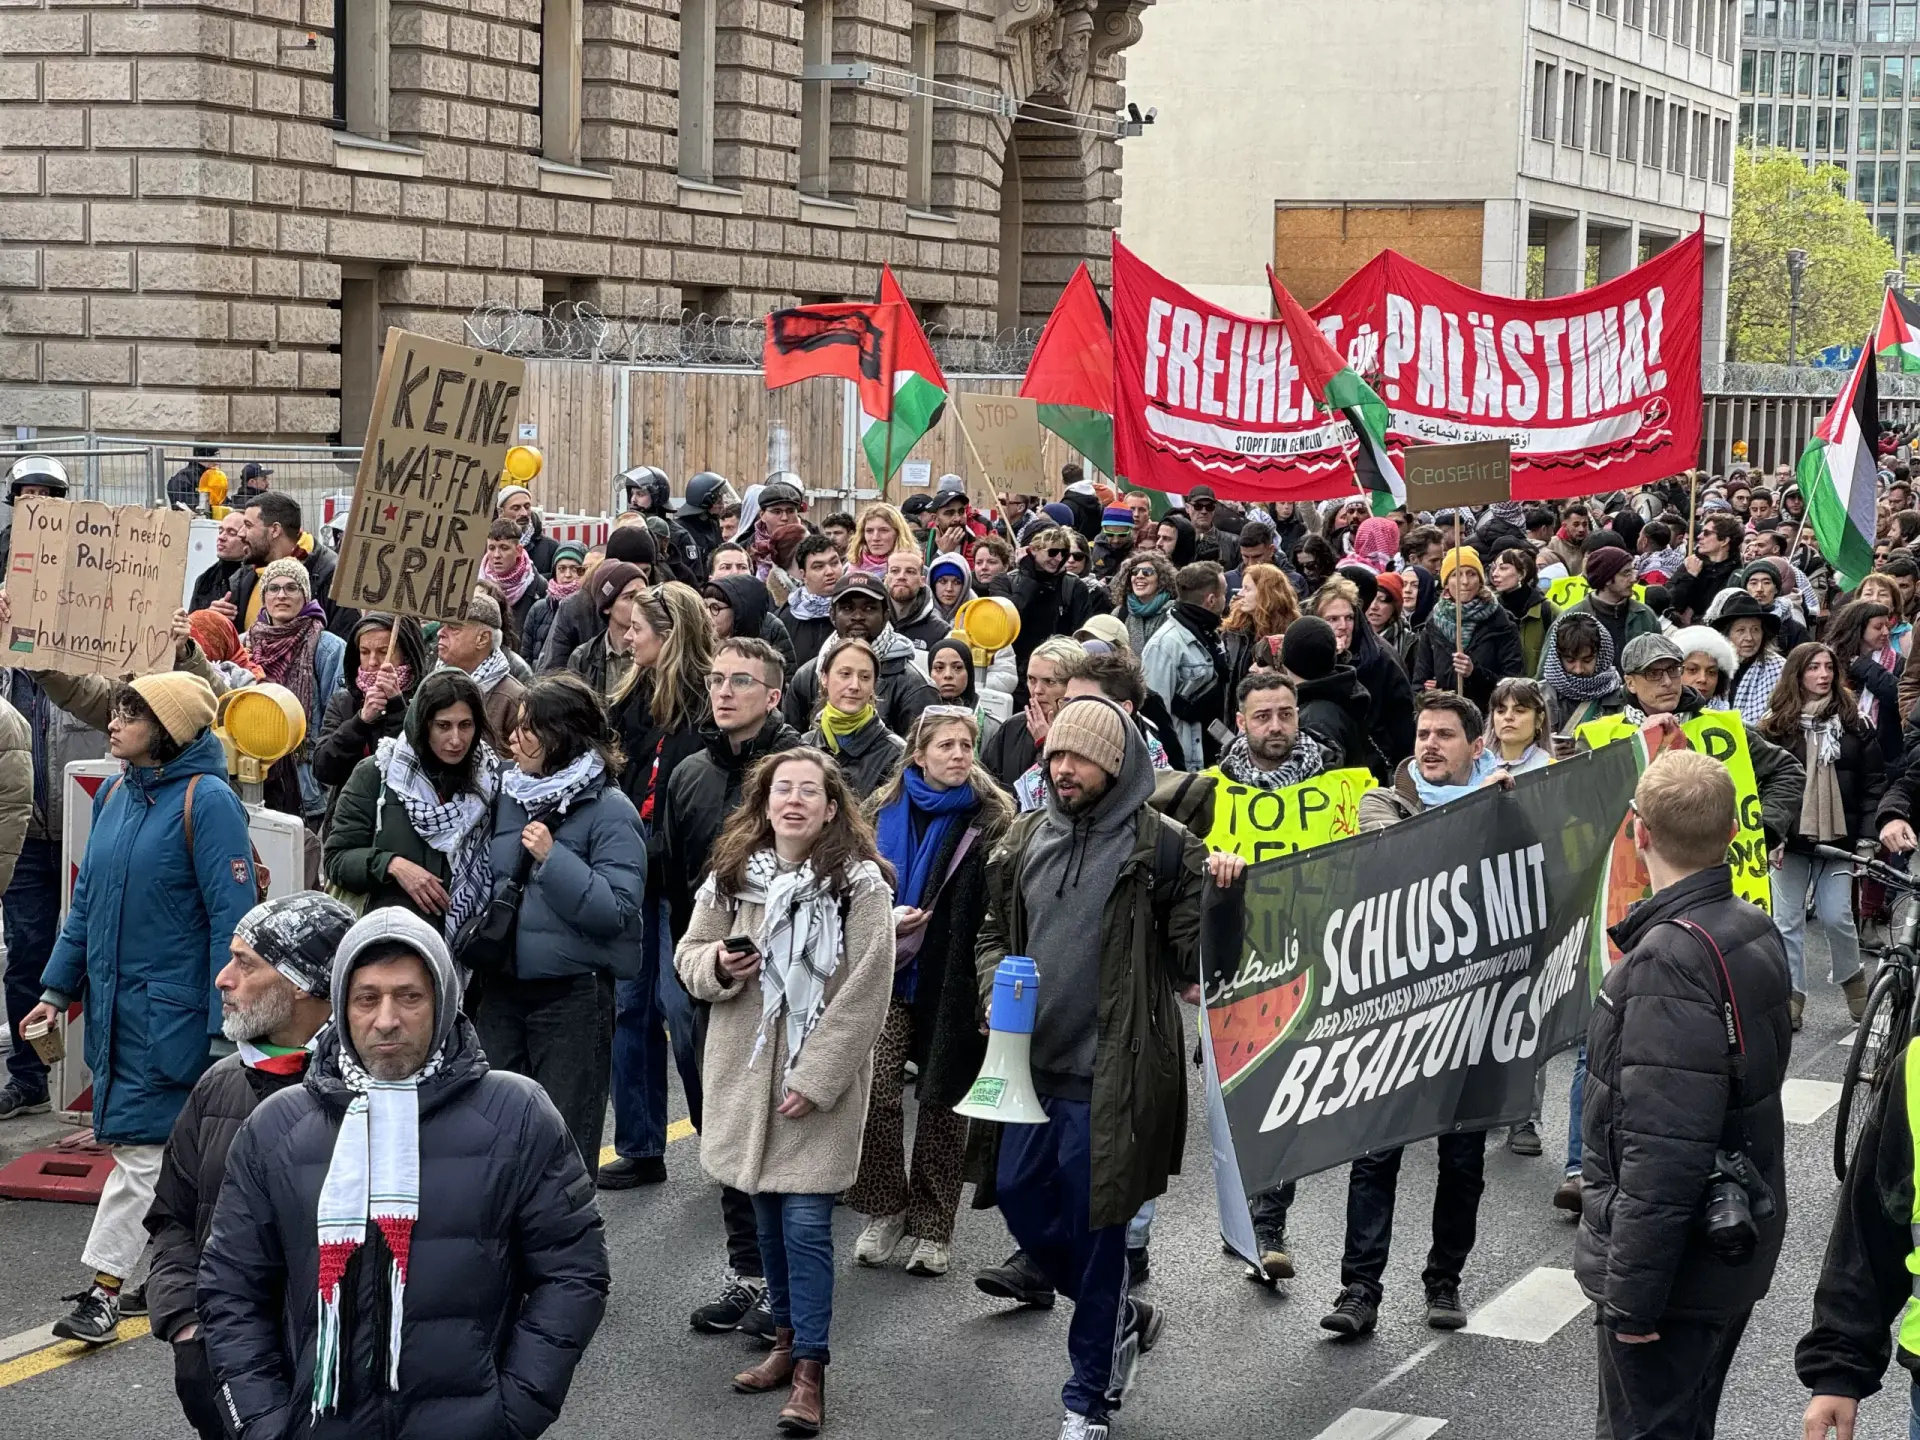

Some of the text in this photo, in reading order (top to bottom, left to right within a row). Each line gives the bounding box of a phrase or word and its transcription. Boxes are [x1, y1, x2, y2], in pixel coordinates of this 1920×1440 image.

[1383, 286, 1668, 421] PALÄSTINA!
[975, 404, 1018, 432] STOP
[1001, 444, 1039, 473] WAR
[1236, 436, 1269, 452] STOPPT
[1271, 438, 1287, 453] DEN
[374, 438, 500, 518] WAFFEN
[26, 504, 62, 532] You
[76, 511, 120, 537] don't
[130, 524, 156, 544] need
[400, 502, 468, 554] FÜR
[40, 543, 159, 580] be Palestinian
[352, 539, 474, 620] ISRAEL
[33, 580, 152, 615] to stand for
[1226, 786, 1330, 836] TOP
[1321, 843, 1547, 1007] SCHLUSS MIT
[1205, 928, 1299, 1005] فلسطين
[1305, 944, 1532, 1042] DER DEUTSCHEN UNTERSTÜTZUNG VON
[1724, 1001, 1736, 1044] Canon
